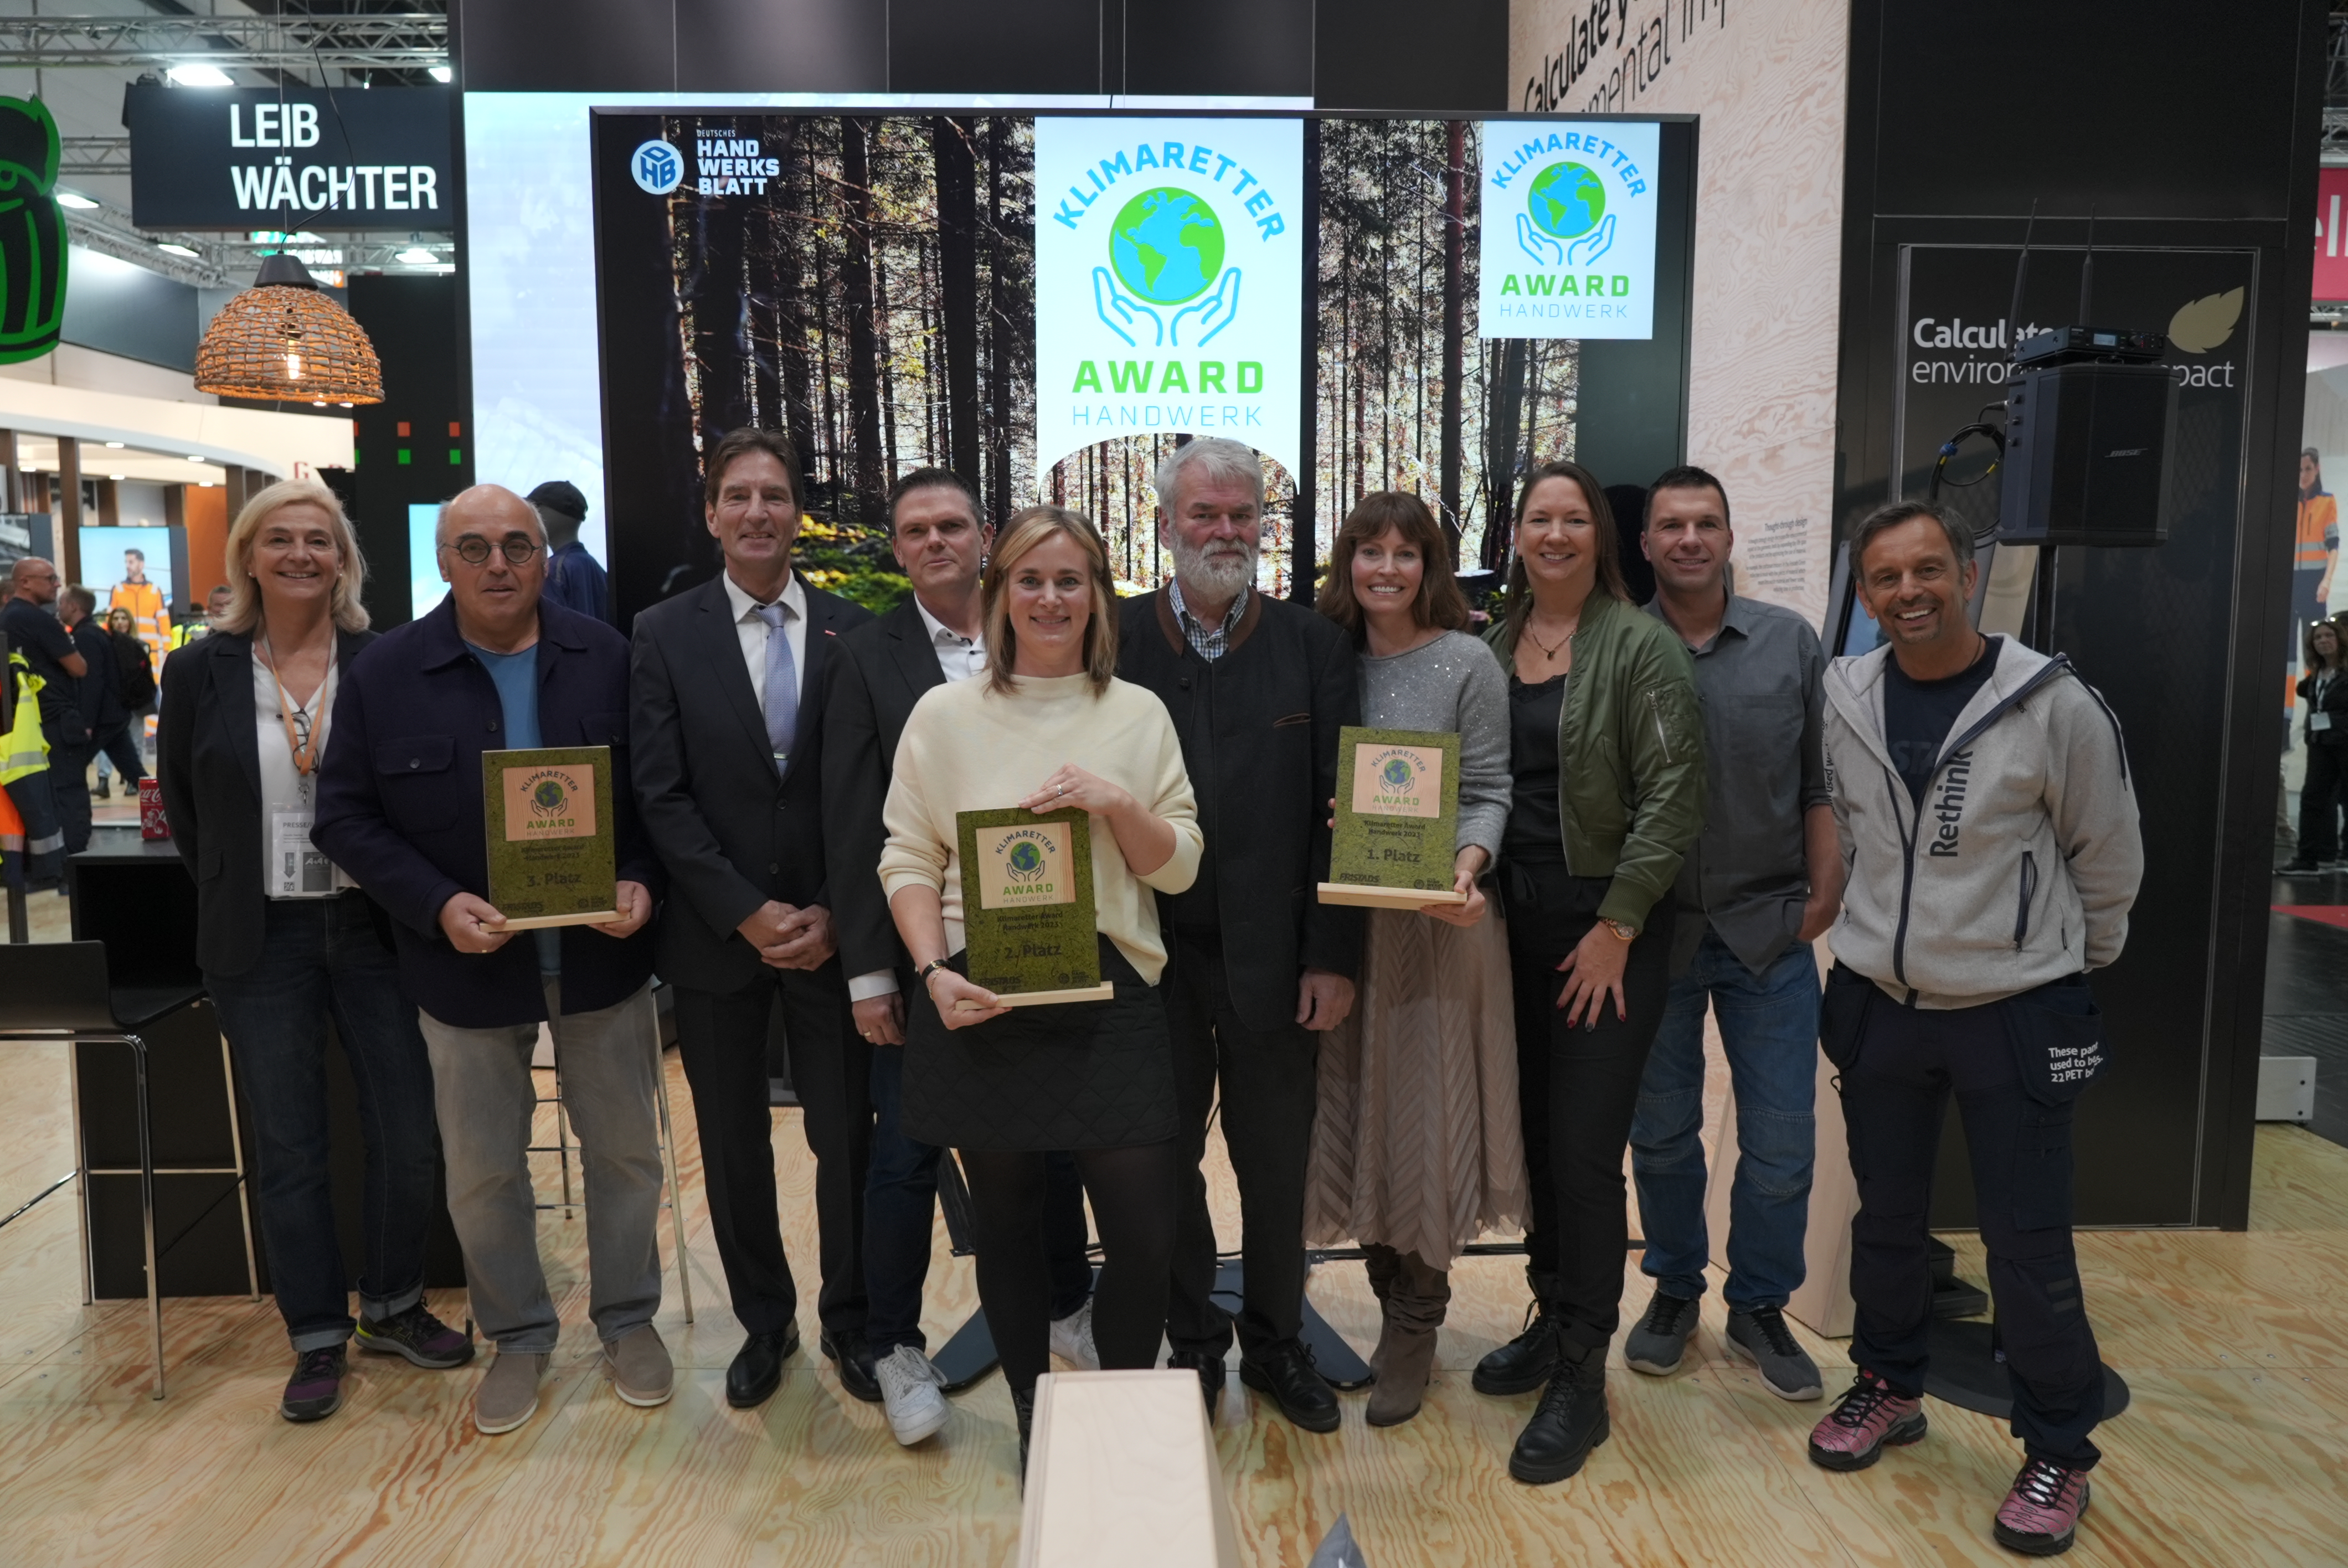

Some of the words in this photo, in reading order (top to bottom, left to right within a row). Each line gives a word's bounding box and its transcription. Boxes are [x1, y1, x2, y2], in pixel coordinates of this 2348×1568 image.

[230, 104, 320, 148] LEIB
[696, 129, 736, 138] DEUTSCHES
[697, 140, 759, 157] HAND
[697, 158, 780, 176] WERKS
[1490, 132, 1647, 199] KLIMARETTER
[230, 157, 439, 210] WÄCHTER
[698, 177, 768, 195] BLATT
[1053, 141, 1285, 243] KLIMARETTER
[1500, 274, 1630, 297] AWARD
[1500, 303, 1628, 318] HANDWERK
[1072, 360, 1264, 394] AWARD
[2171, 360, 2236, 388] pact
[1072, 405, 1262, 427] HANDWERK
[2109, 448, 2143, 458] BOSE
[1371, 749, 1426, 773] KLIMARETTER
[520, 770, 578, 792] KLIMARETTER
[1372, 795, 1420, 806] AWARD
[1372, 804, 1419, 813] HANDWERK
[1929, 750, 1974, 857] Rethink
[526, 818, 575, 829] AWARD
[1404, 822, 1425, 831] Award
[526, 828, 575, 837] HANDWERK
[1368, 828, 1402, 837] Handwerk
[995, 830, 1055, 855] KLIMARETTER
[1366, 849, 1380, 860] 1.
[1383, 848, 1421, 863] Platz
[526, 875, 542, 888] 3.
[544, 872, 582, 885] Platz
[1002, 883, 1053, 896] AWARD
[1003, 894, 1054, 904] HANDWERK
[997, 914, 1039, 922] Klimaretter
[1004, 947, 1019, 959] 2.
[1023, 943, 1062, 958] Platz
[2048, 1047, 2078, 1058] These
[2050, 1057, 2072, 1071] used
[2073, 1058, 2086, 1067] to
[2051, 1073, 2065, 1082] 22
[2065, 1069, 2084, 1081] PET
